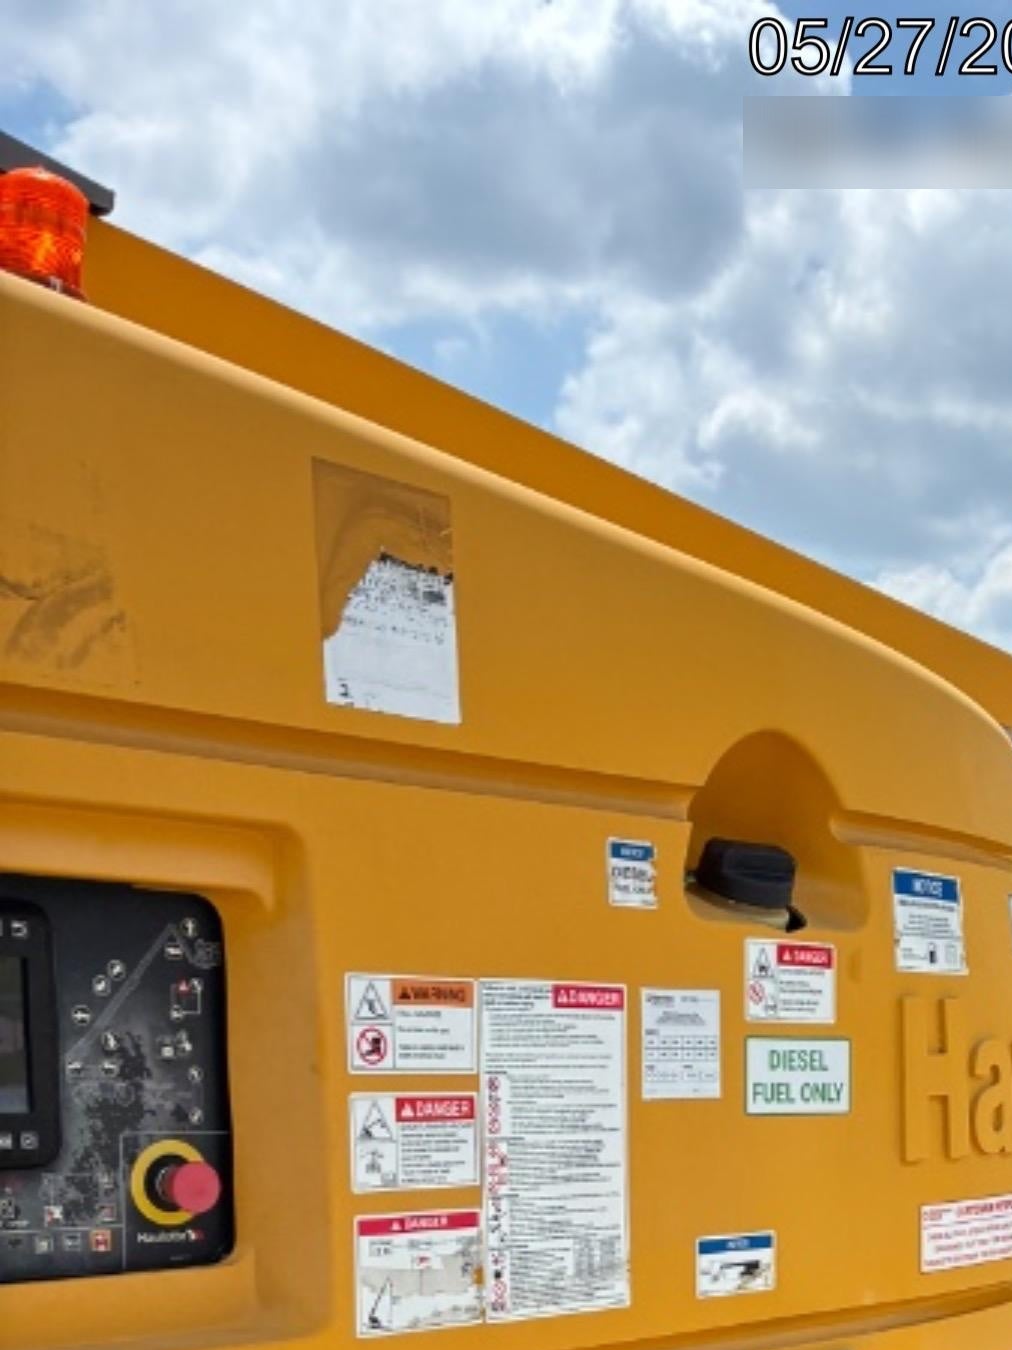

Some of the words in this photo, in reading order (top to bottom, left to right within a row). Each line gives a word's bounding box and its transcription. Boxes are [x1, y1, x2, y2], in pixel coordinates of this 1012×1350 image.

[793, 948, 829, 964] DANGER
[411, 986, 466, 1003] WARNING
[569, 988, 620, 1006] DANGER
[768, 1049, 829, 1072] DIESEL
[752, 1082, 796, 1104] FUEL
[800, 1081, 844, 1103] ONLY
[416, 1100, 470, 1118] DANGER
[404, 1215, 448, 1231] DANGER
